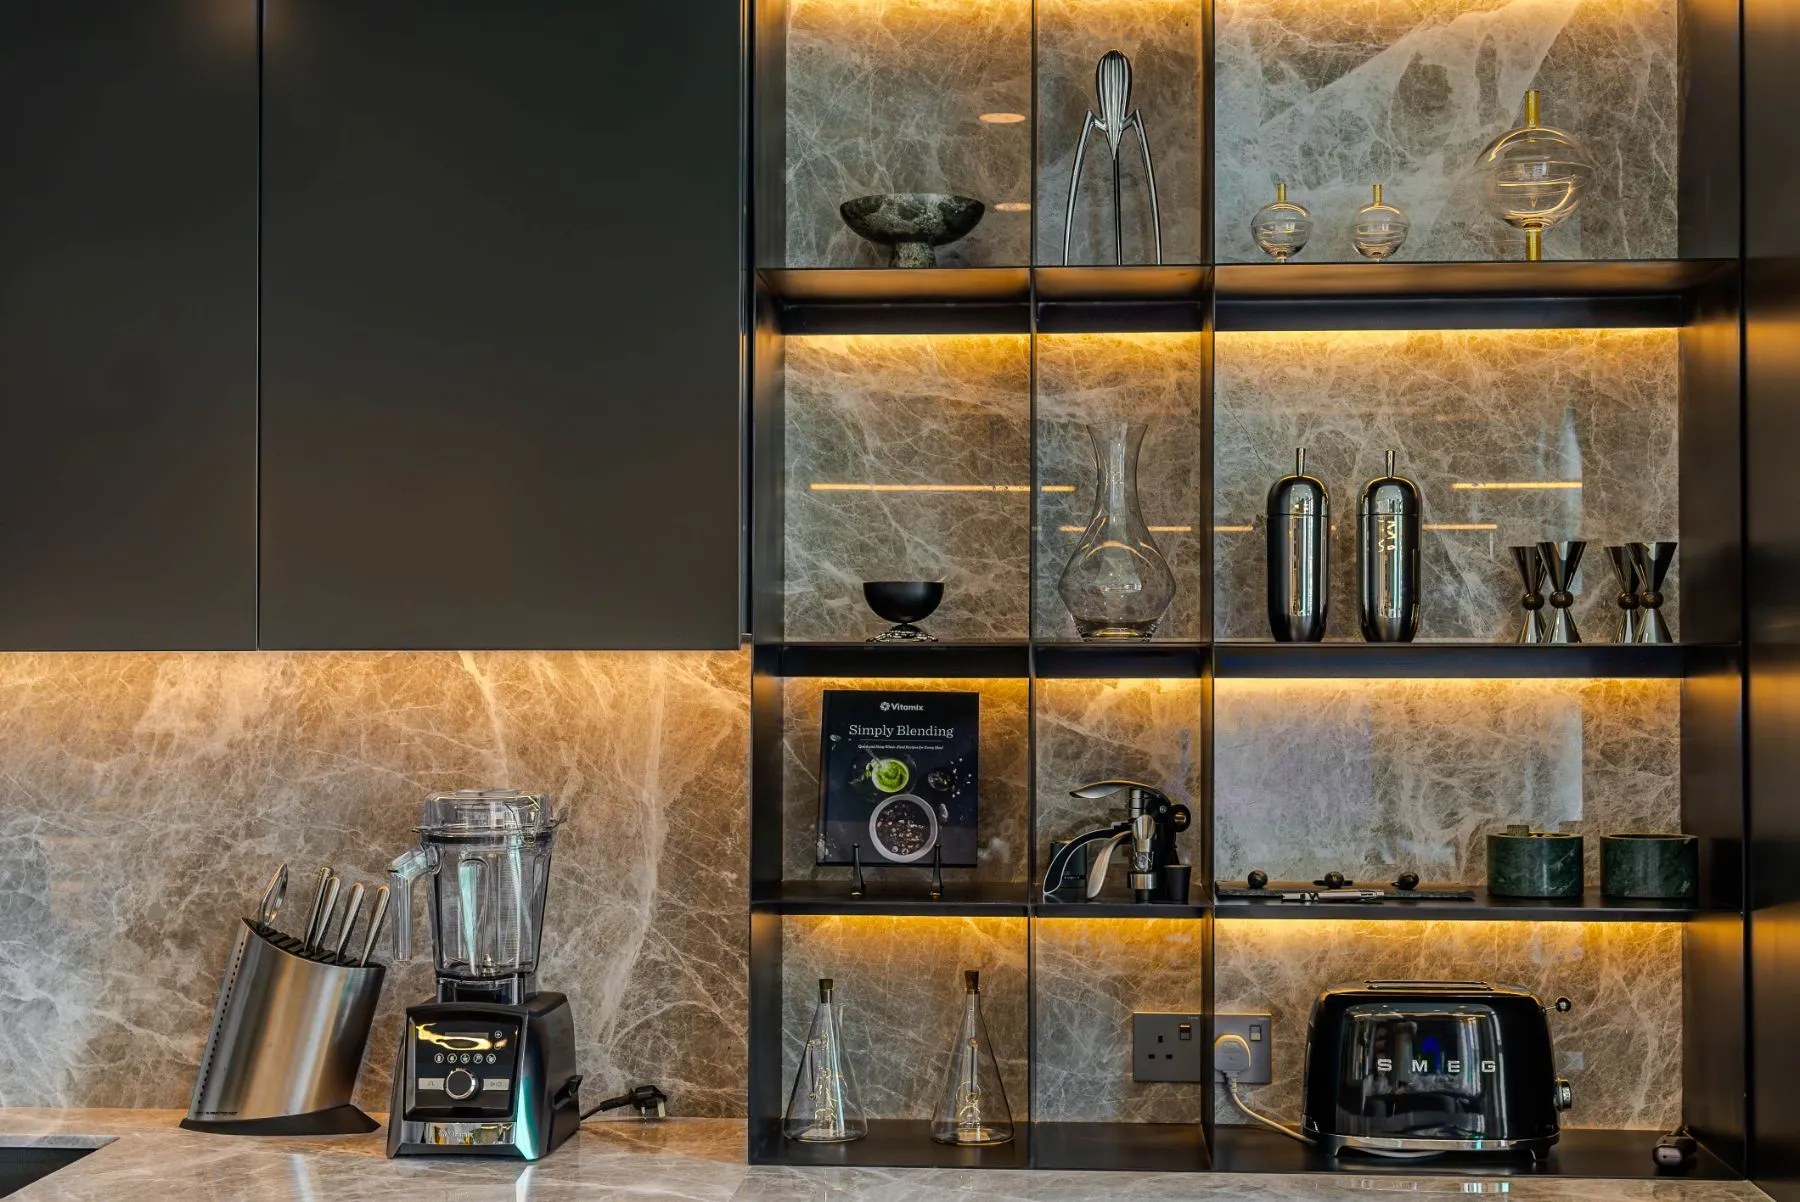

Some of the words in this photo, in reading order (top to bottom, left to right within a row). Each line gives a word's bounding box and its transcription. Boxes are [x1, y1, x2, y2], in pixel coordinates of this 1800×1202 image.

[891, 703, 924, 711] Vitamix
[849, 724, 895, 737] Simply
[896, 725, 954, 738] Blending
[1377, 1058, 1496, 1073] SMEG
